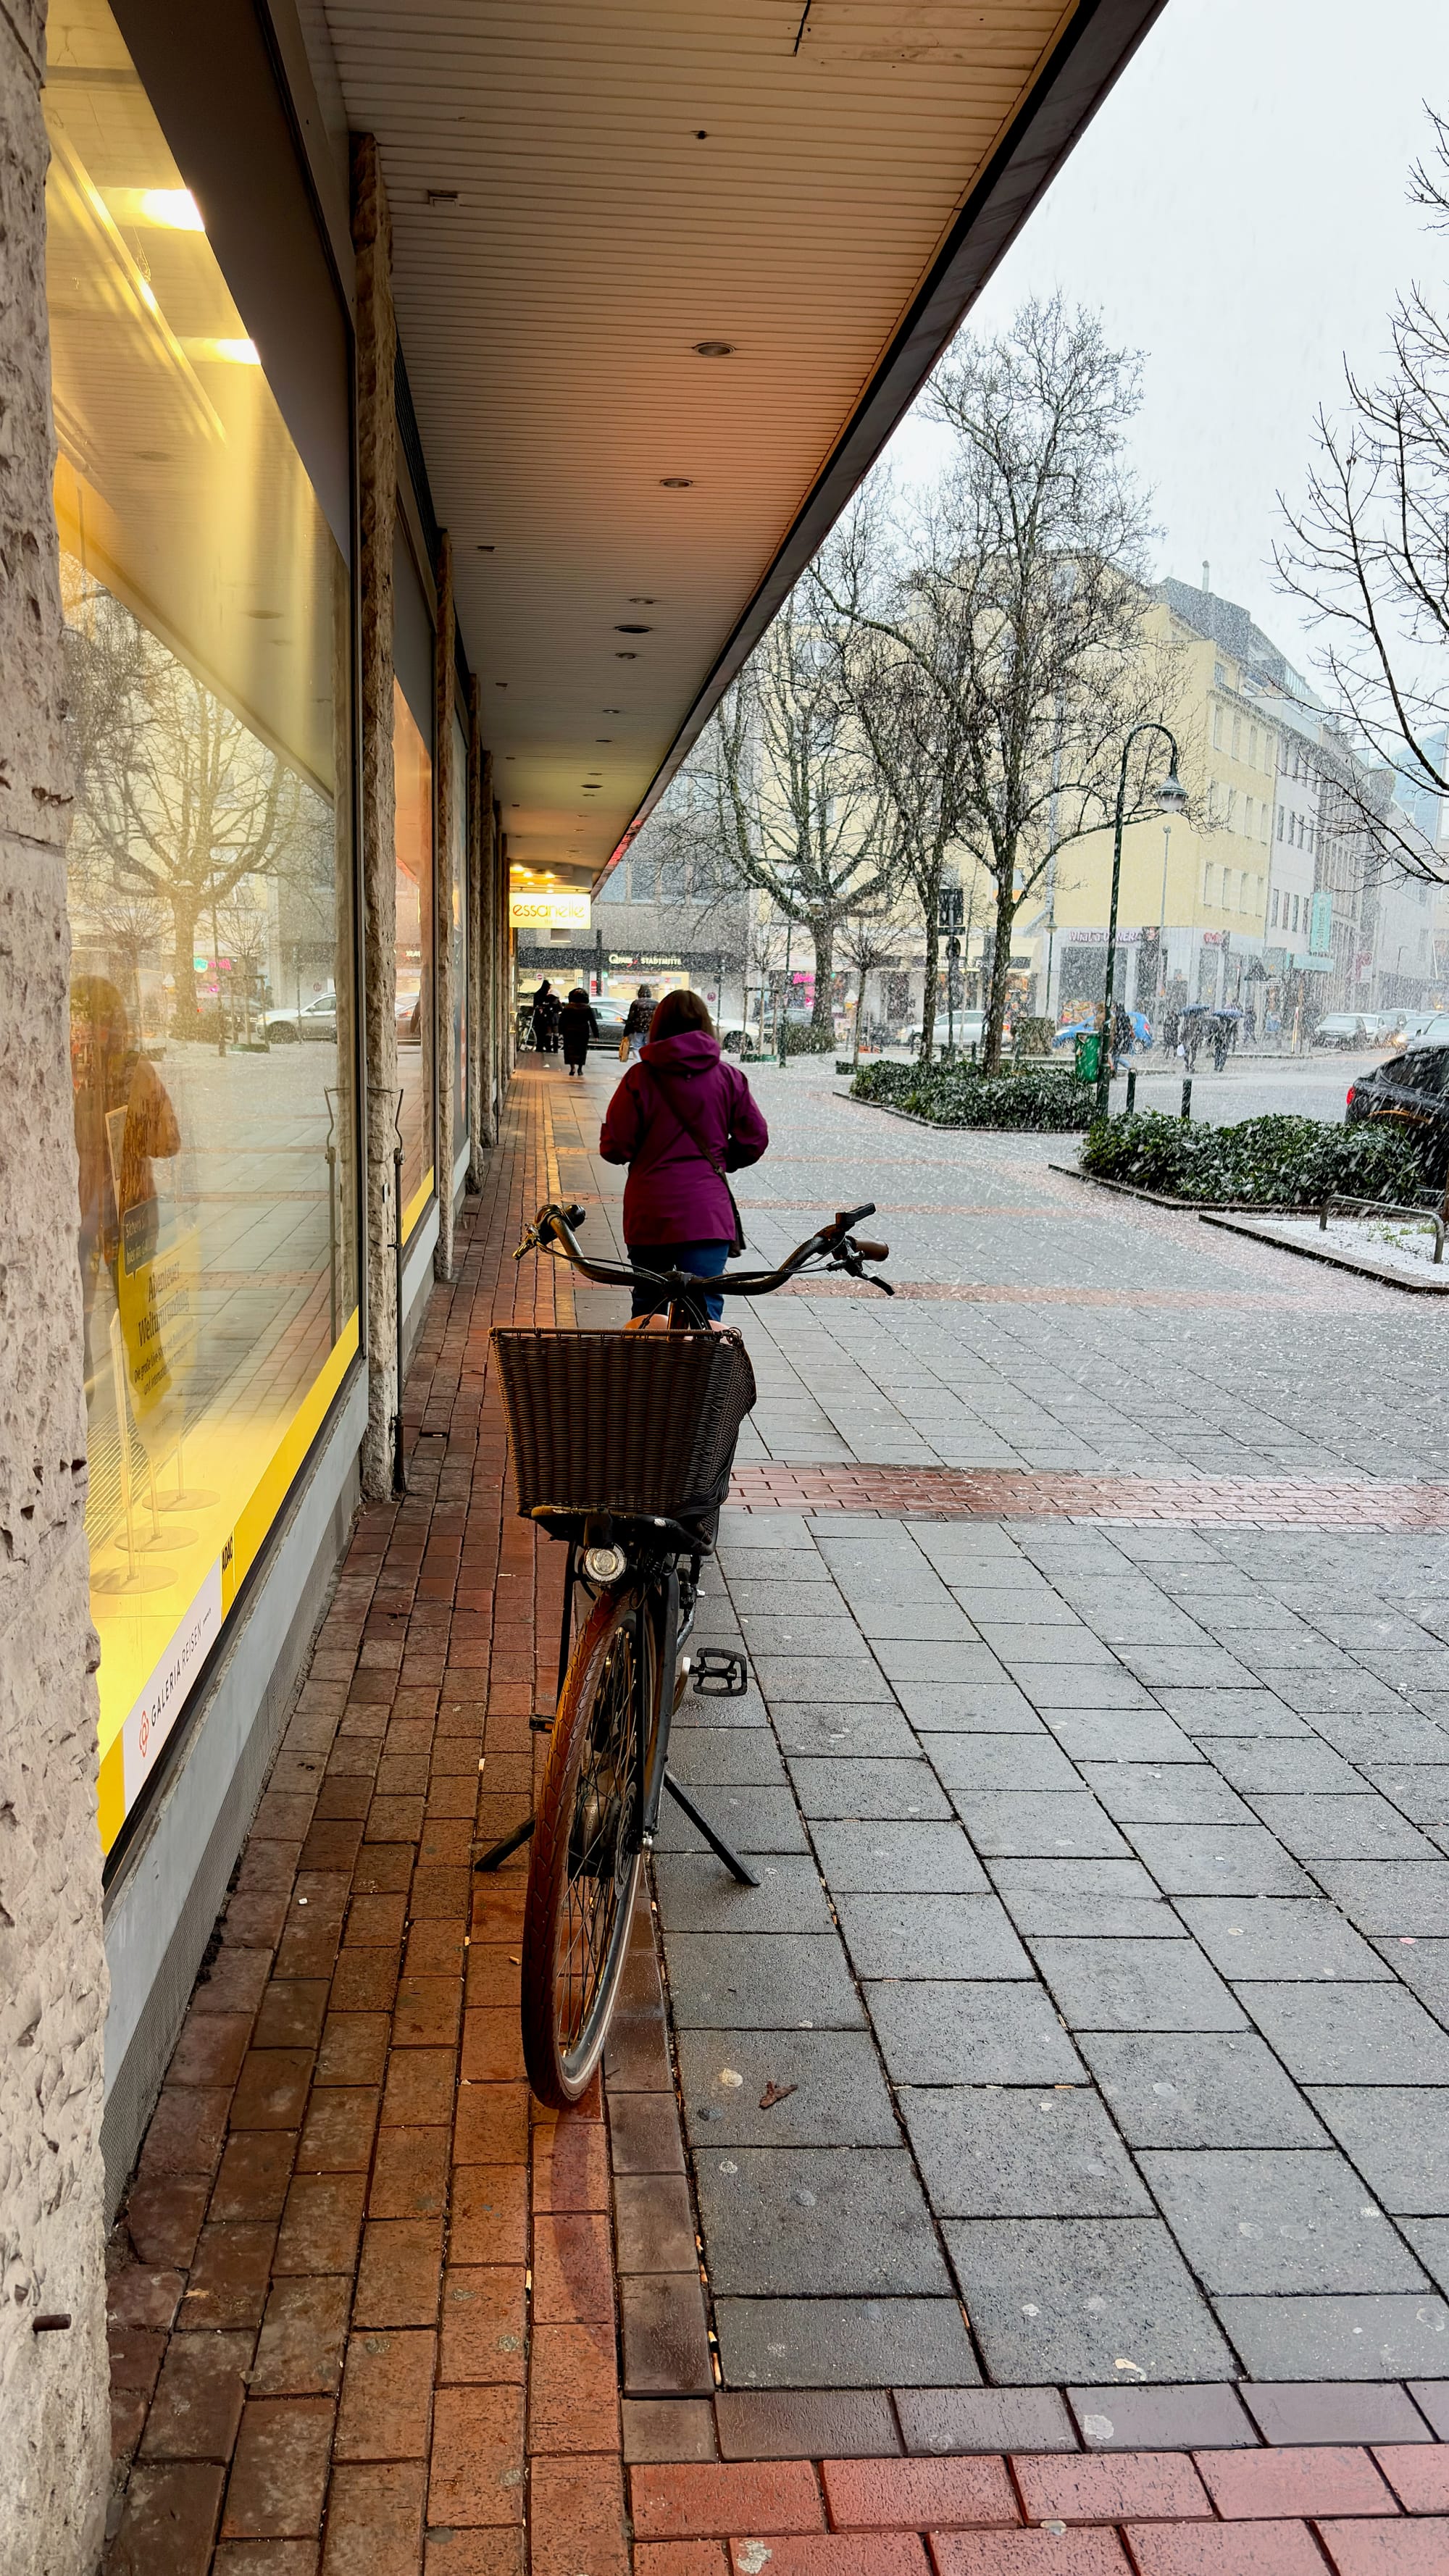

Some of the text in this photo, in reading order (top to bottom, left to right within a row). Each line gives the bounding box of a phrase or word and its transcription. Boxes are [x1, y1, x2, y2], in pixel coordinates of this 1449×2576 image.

[512, 899, 585, 919] essanelle
[640, 956, 682, 966] STADTMITTE
[221, 1535, 233, 1575] ADAC
[151, 1618, 202, 1727] GALERIA REISEN
